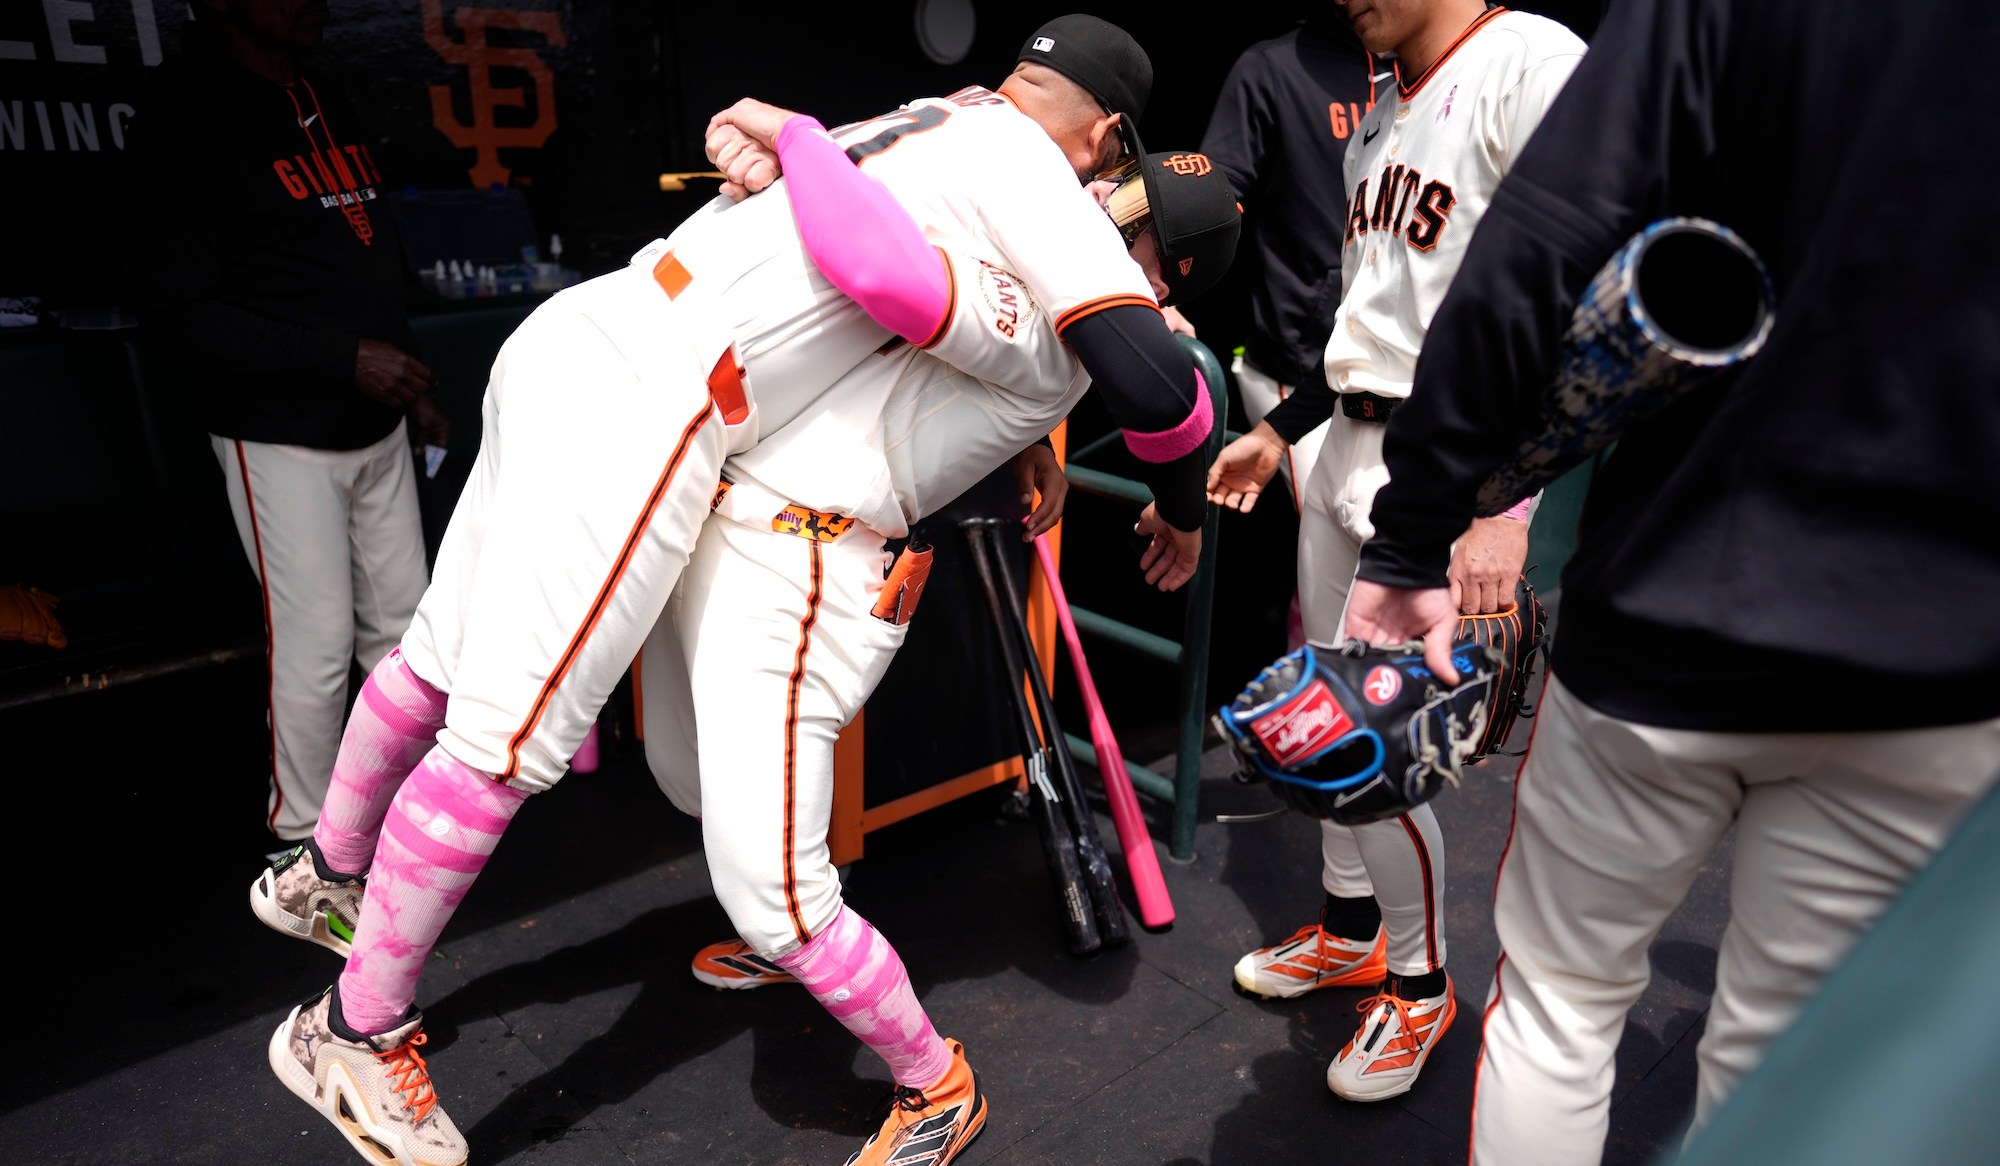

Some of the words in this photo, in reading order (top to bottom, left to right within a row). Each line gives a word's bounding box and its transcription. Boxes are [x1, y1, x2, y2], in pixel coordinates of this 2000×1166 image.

[1329, 102, 1375, 139] GI
[320, 188, 364, 208] BASBAL
[1345, 164, 1456, 252] ANTS
[980, 260, 1017, 338] IANTS
[1362, 399, 1375, 418] 51
